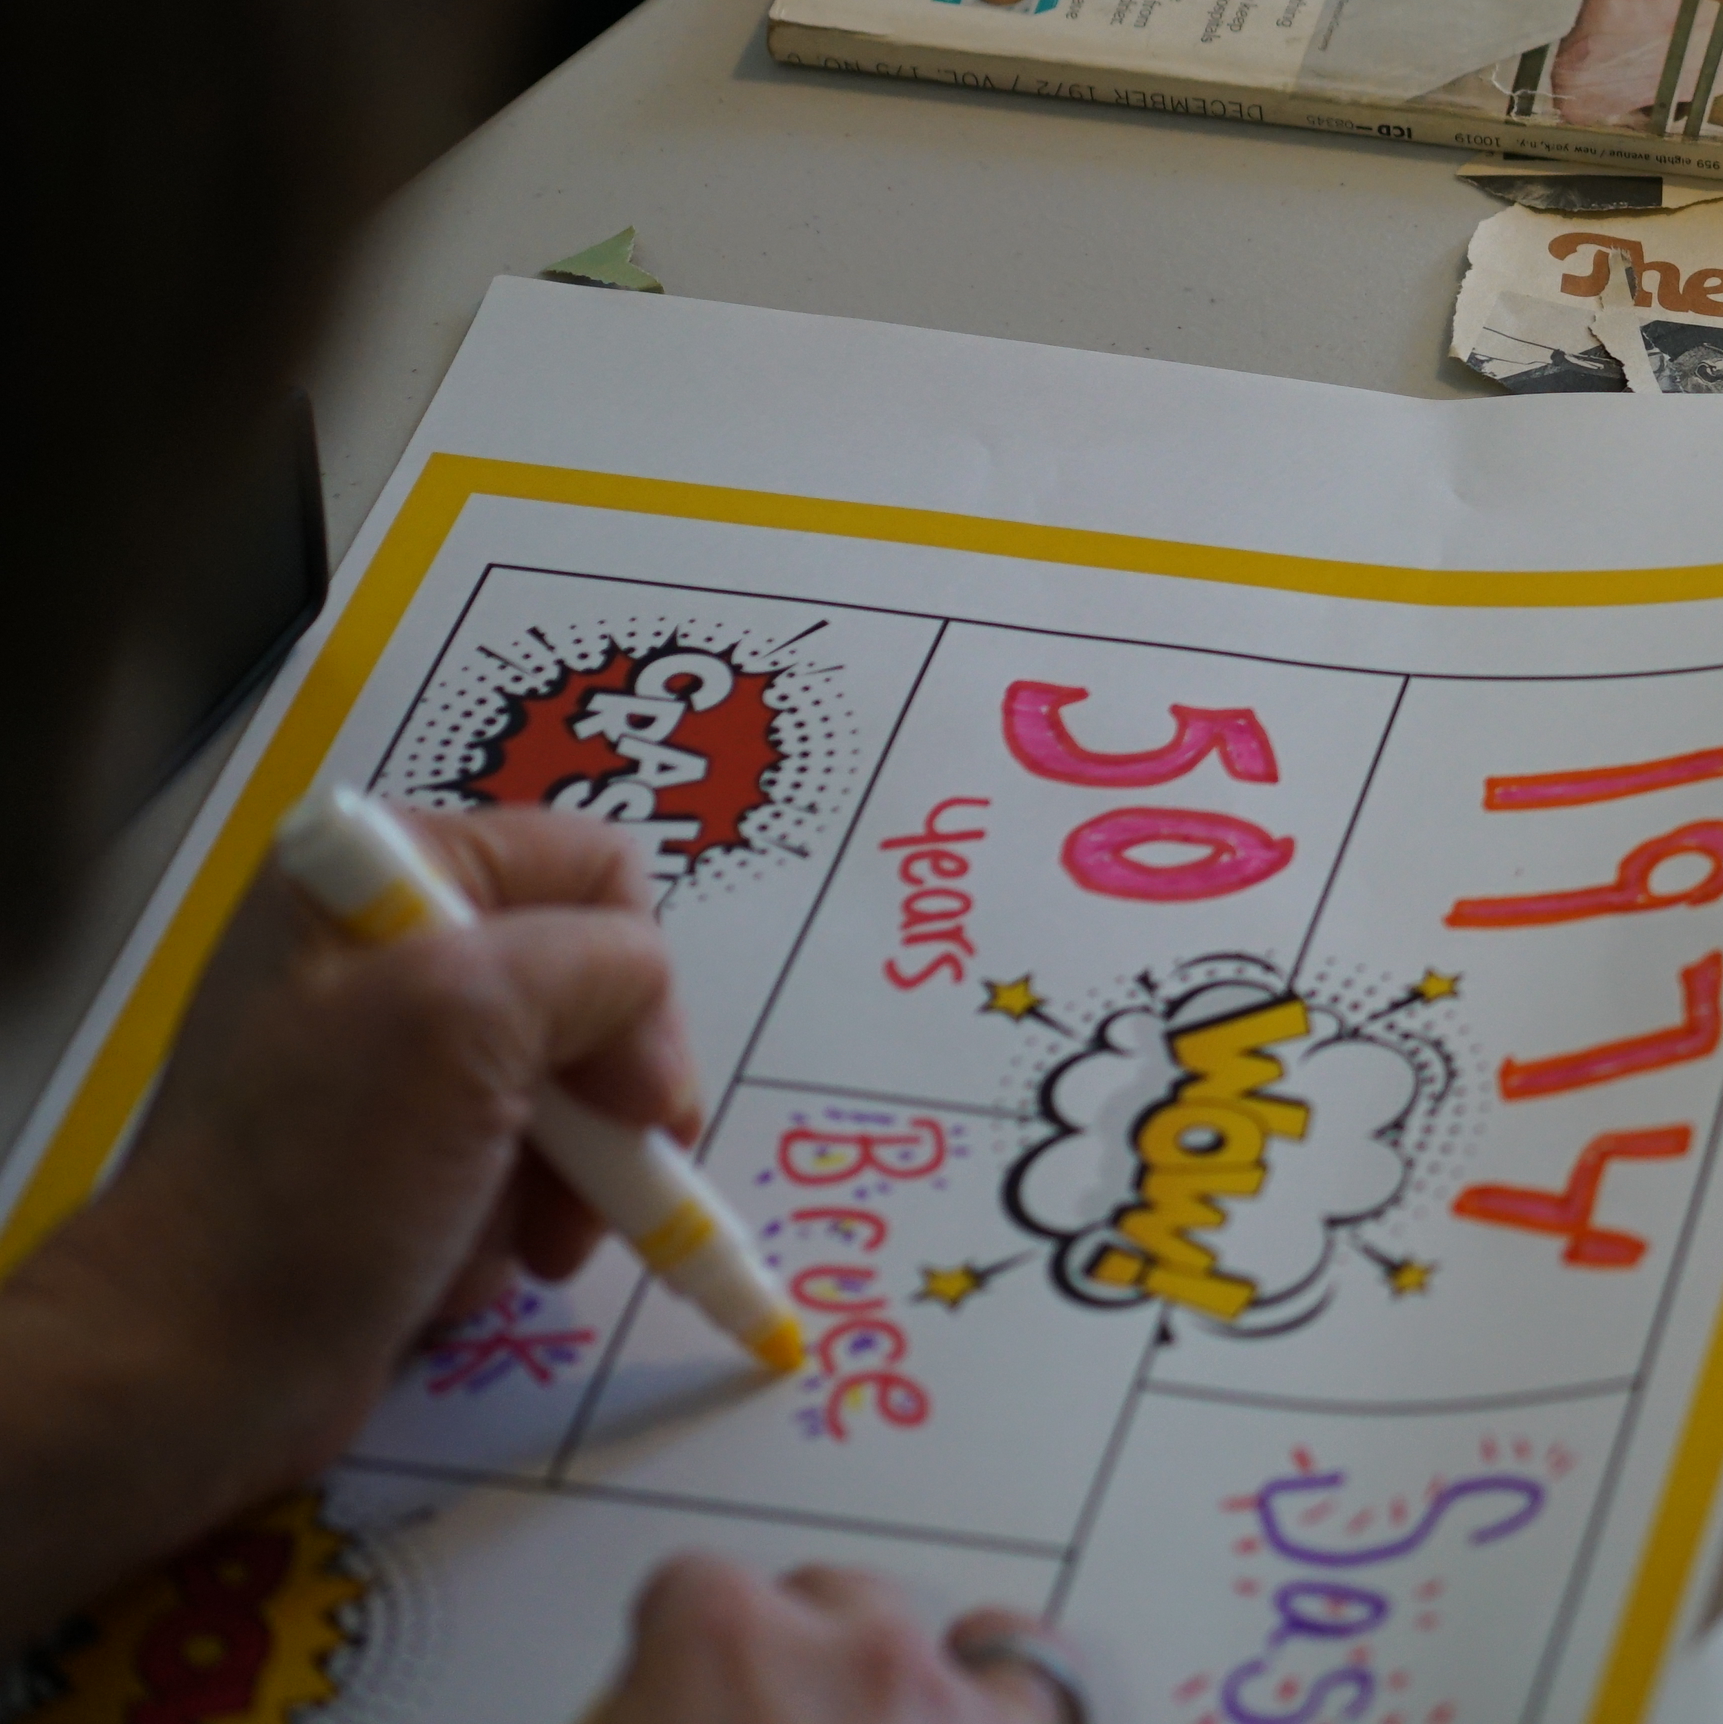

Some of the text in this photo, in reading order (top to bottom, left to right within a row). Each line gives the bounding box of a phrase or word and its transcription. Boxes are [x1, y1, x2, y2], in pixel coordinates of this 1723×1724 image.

[1224, 1, 1254, 34] keep
[1035, 78, 1098, 104] 1972
[1114, 87, 1265, 123] DECEMBER
[1453, 133, 1502, 148] 10019
[1573, 145, 1598, 156] new
[1608, 148, 1651, 162] avenue
[1654, 153, 1692, 167] eighth
[1696, 159, 1722, 171] 959
[1001, 677, 1298, 902] 50
[879, 794, 992, 992] years
[1087, 994, 1311, 1324] WOW!
[775, 1114, 945, 1446] Bruce
